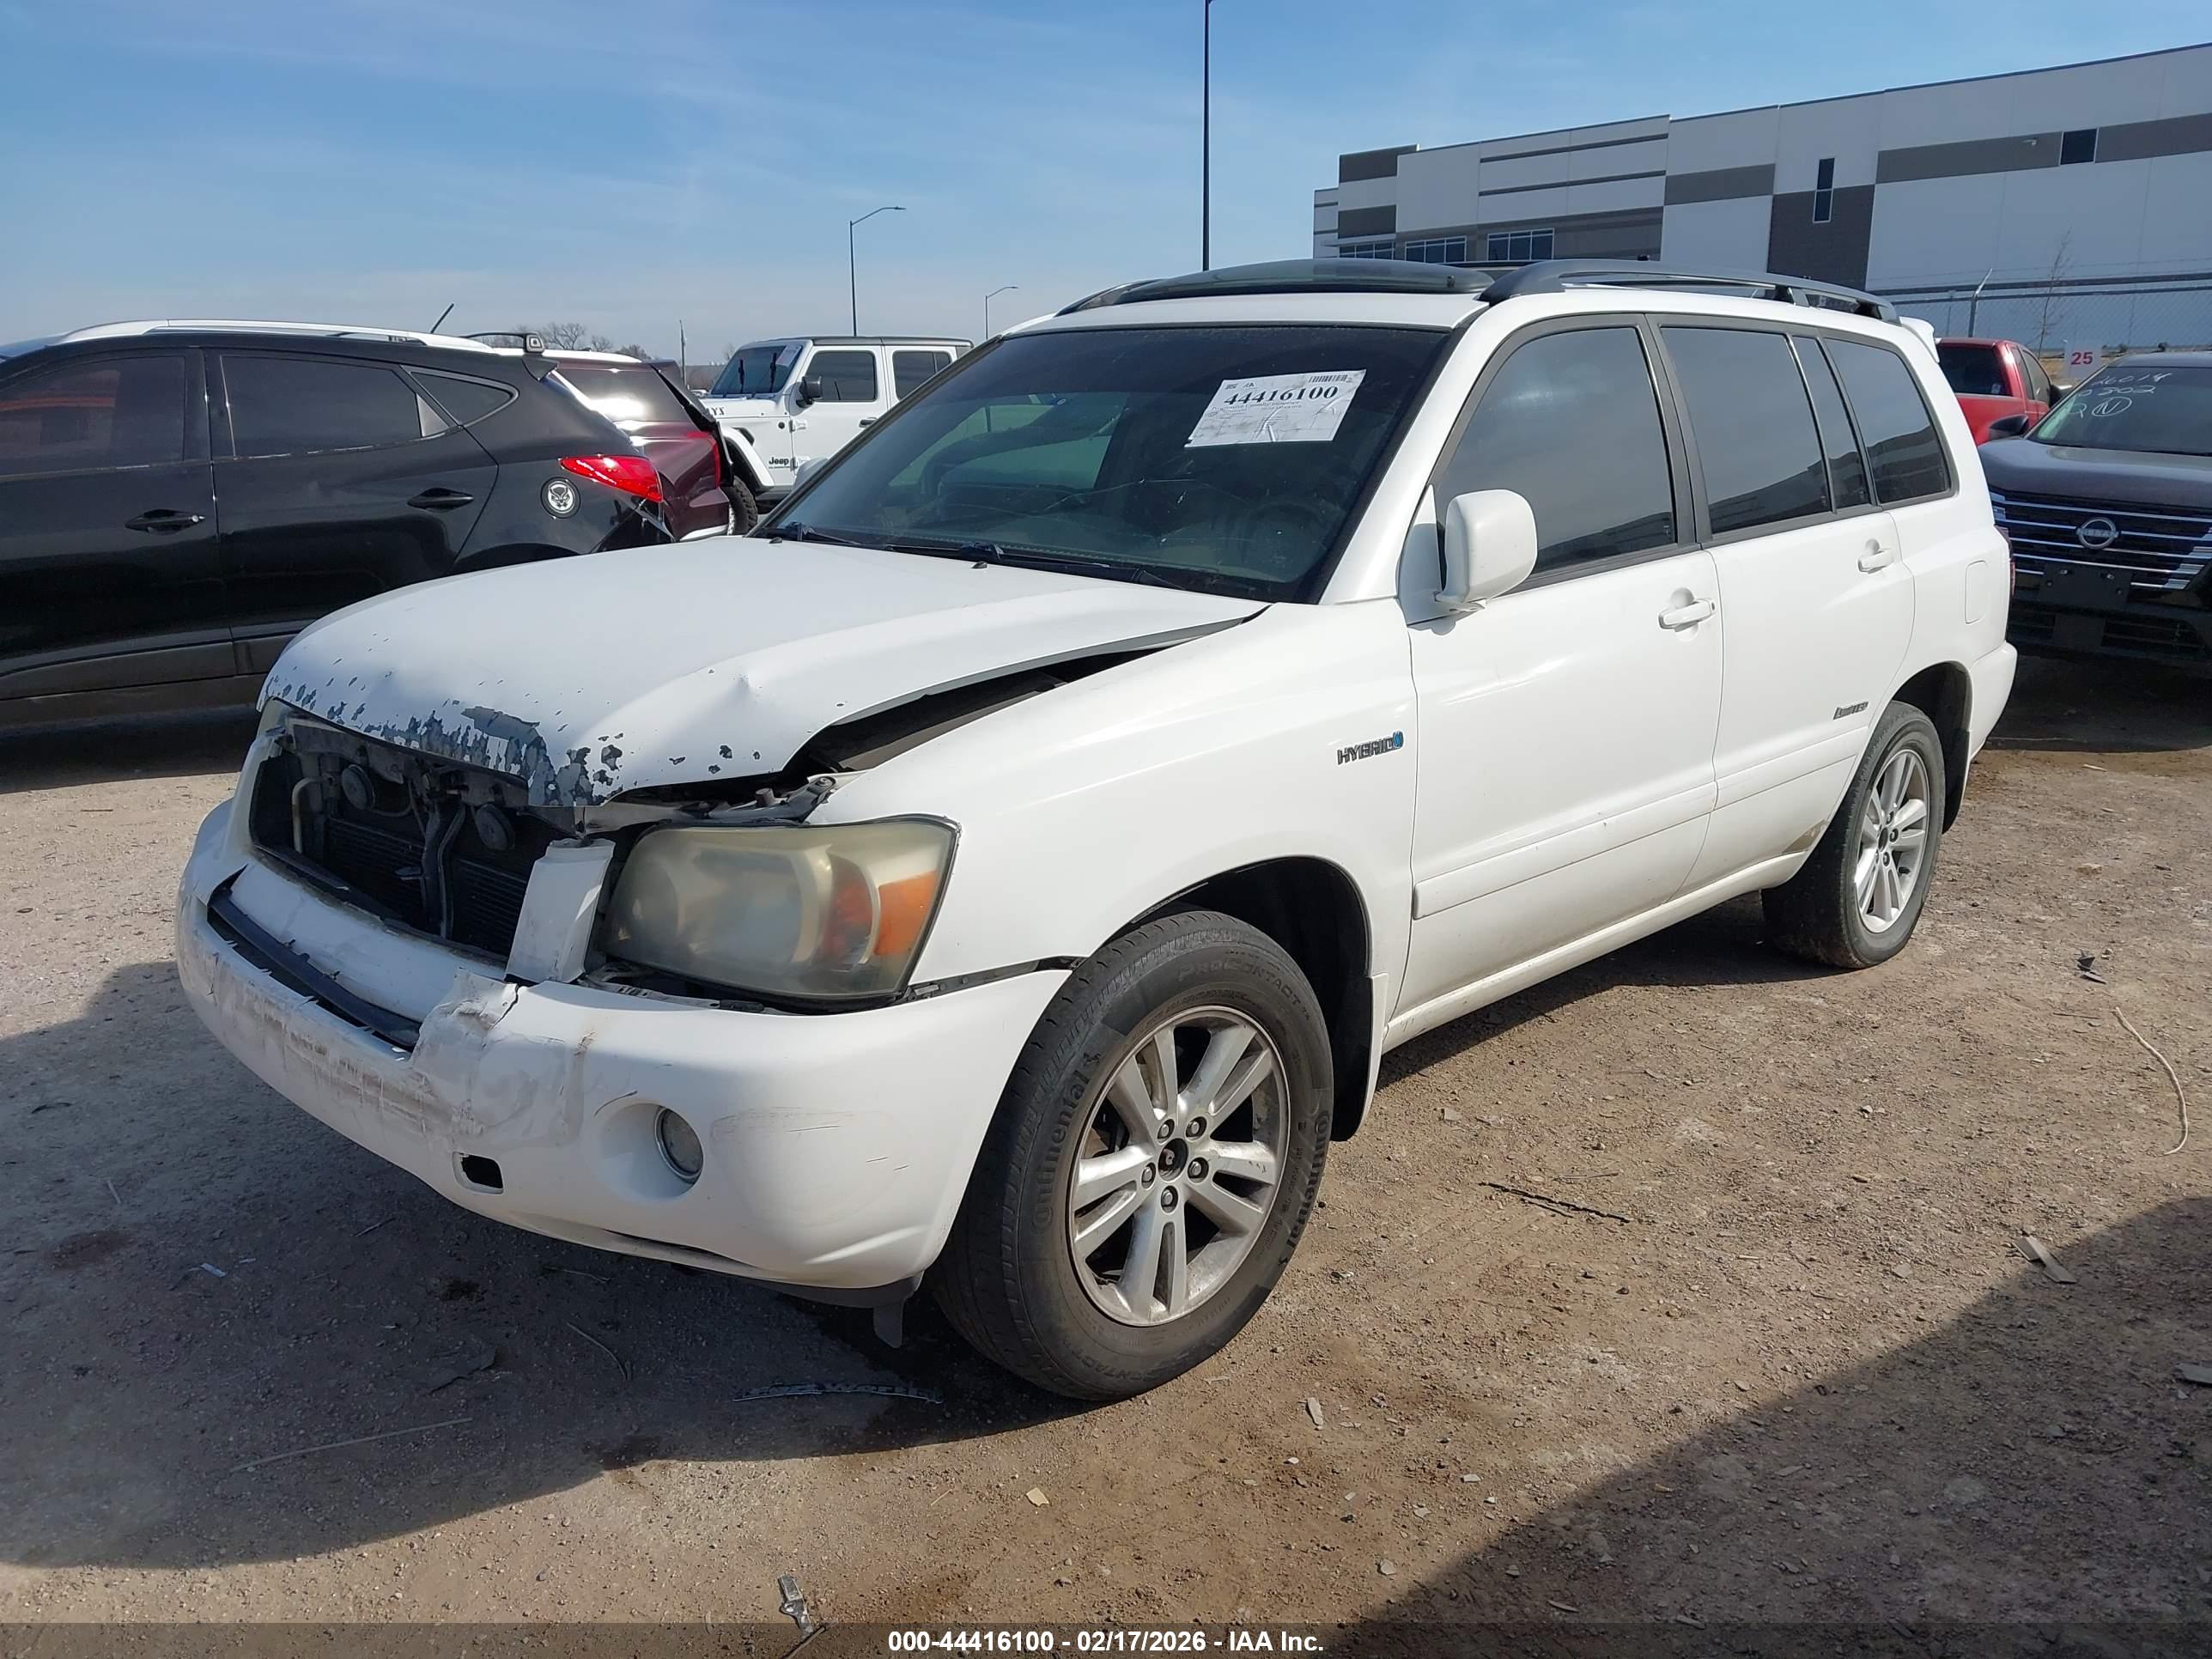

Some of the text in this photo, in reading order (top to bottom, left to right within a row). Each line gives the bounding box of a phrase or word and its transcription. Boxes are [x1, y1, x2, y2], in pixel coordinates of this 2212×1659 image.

[2070, 351, 2094, 366] 25
[1223, 386, 1340, 405] 44416100
[769, 456, 789, 466] Jeep
[1337, 736, 1395, 765] HYBRID
